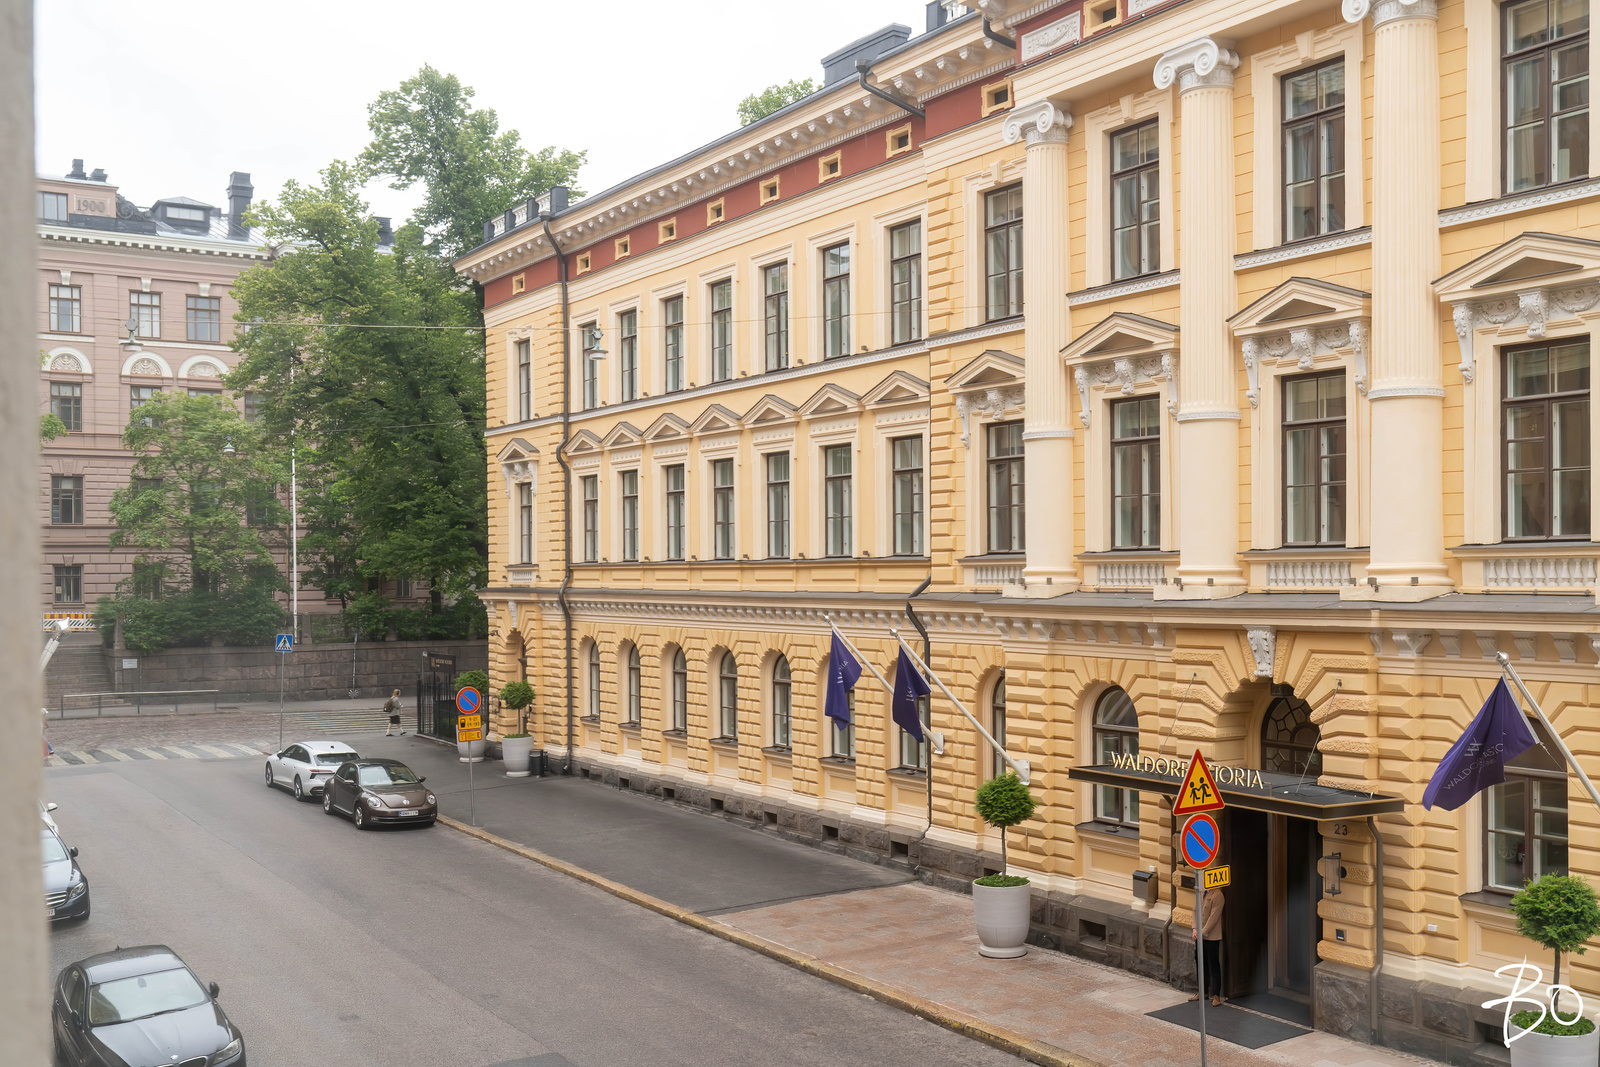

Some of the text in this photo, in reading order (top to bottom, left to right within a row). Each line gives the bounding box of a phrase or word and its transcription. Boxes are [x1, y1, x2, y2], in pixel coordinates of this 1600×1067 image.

[77, 199, 106, 213] 1900
[1208, 763, 1264, 790] TORIA
[1334, 823, 1348, 836] 23
[1207, 870, 1228, 884] TAXI
